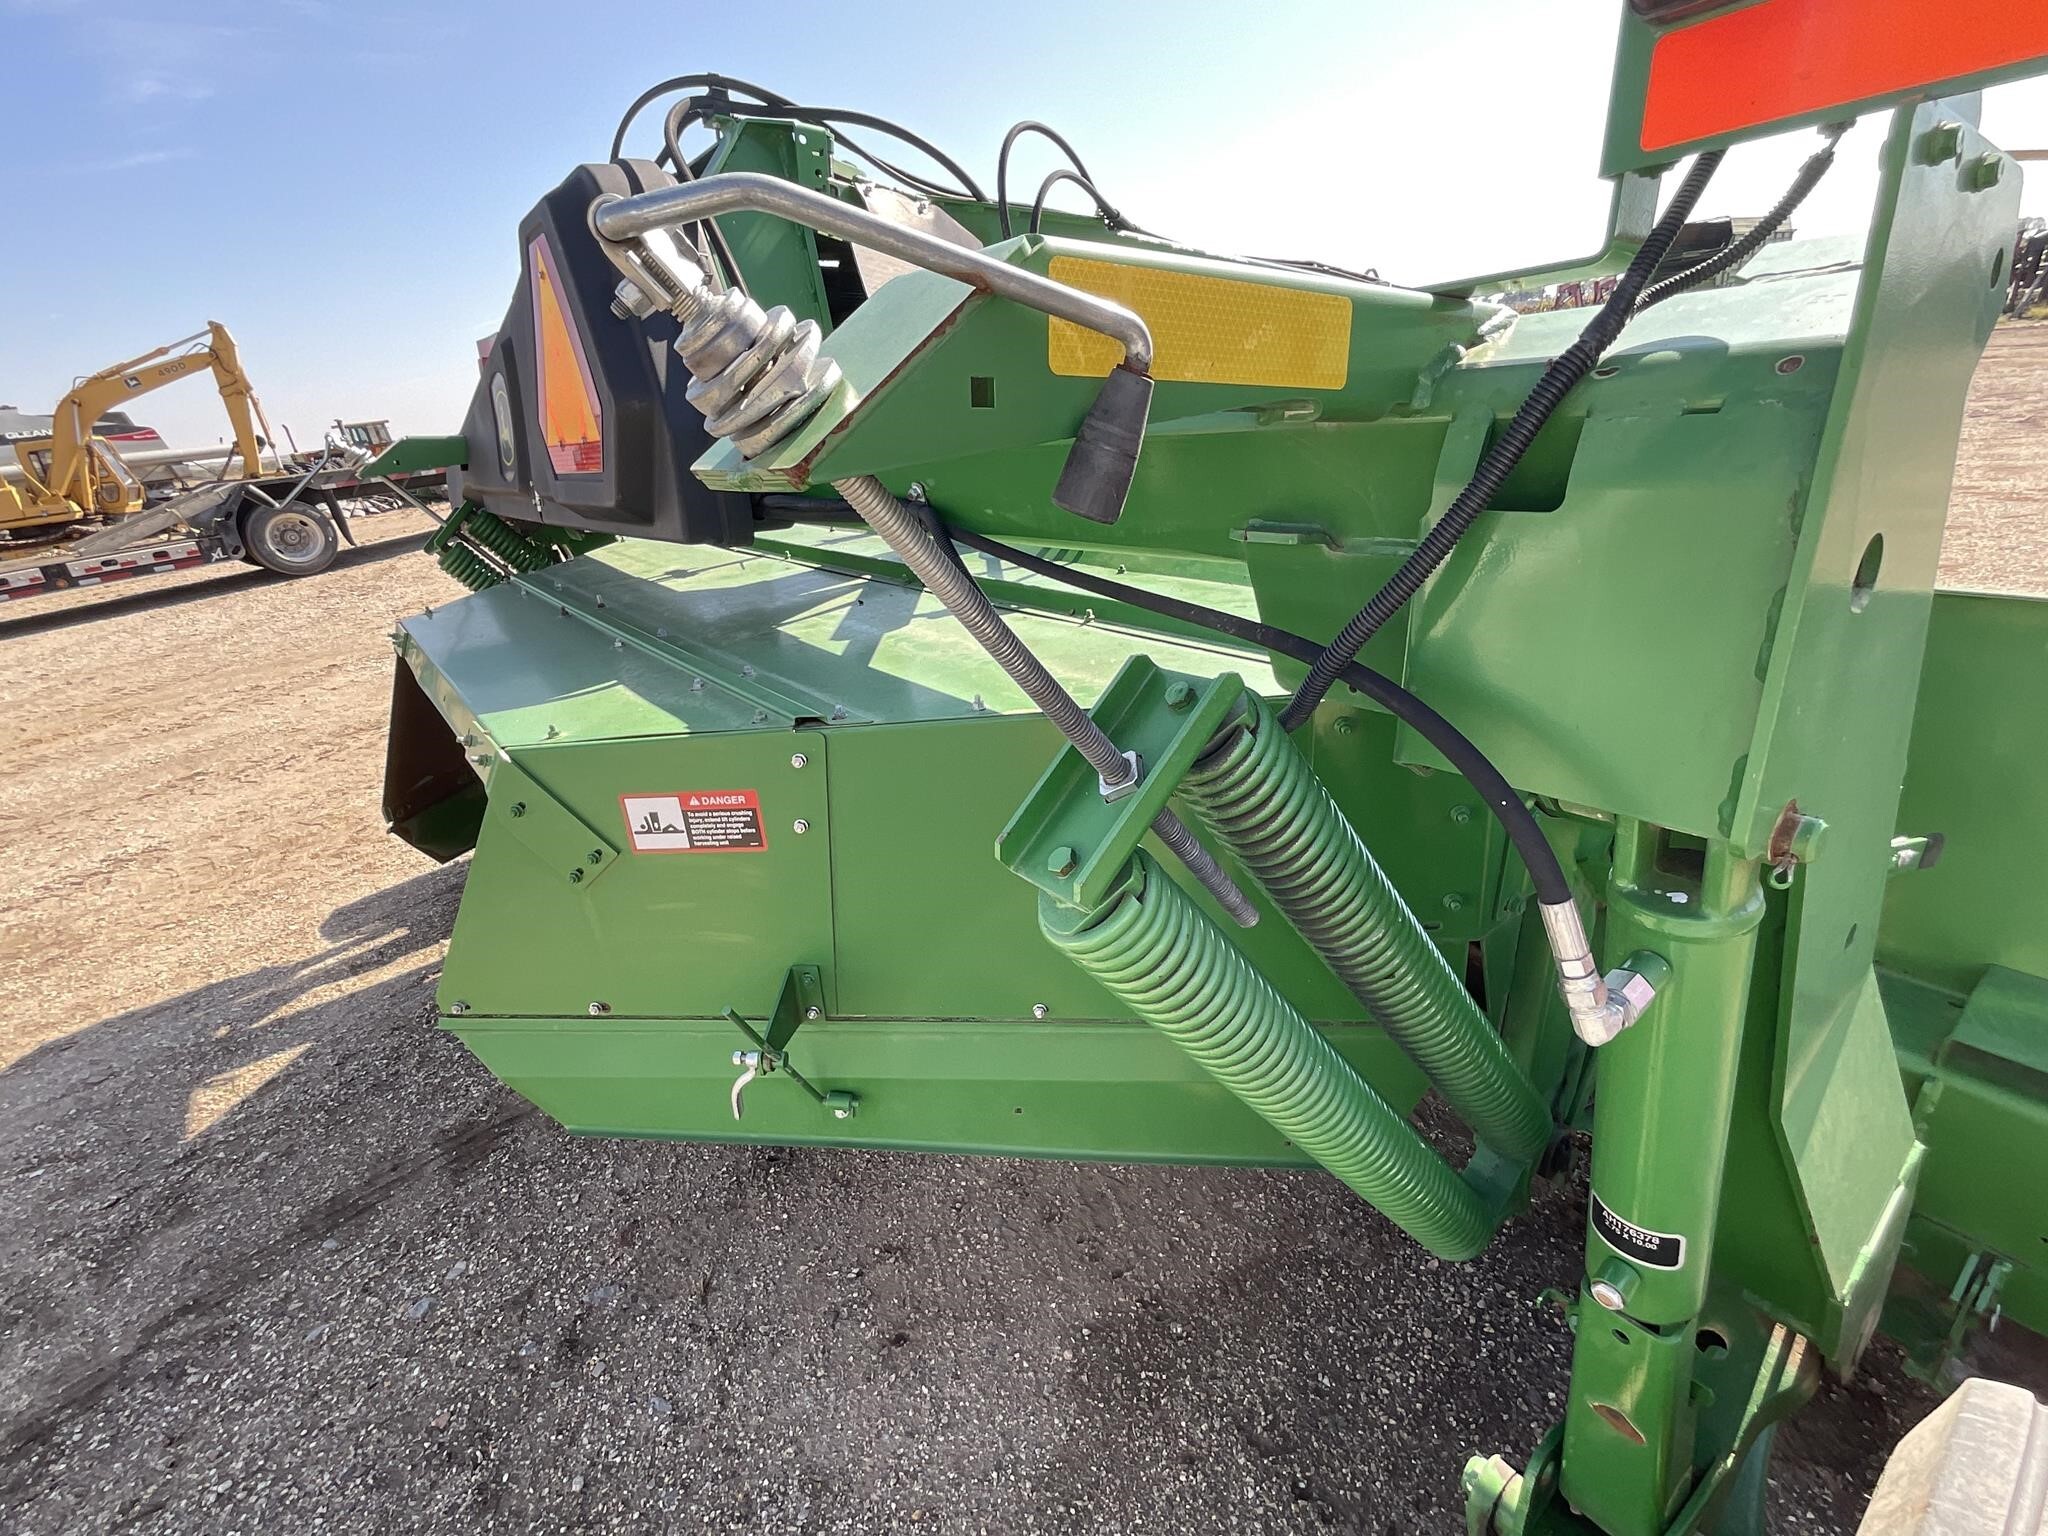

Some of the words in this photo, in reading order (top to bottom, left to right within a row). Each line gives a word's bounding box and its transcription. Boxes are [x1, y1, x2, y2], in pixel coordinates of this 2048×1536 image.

[701, 796, 746, 805] DANGER
[1603, 1211, 1659, 1244] AH176378
[1632, 1238, 1658, 1250] 10.00
